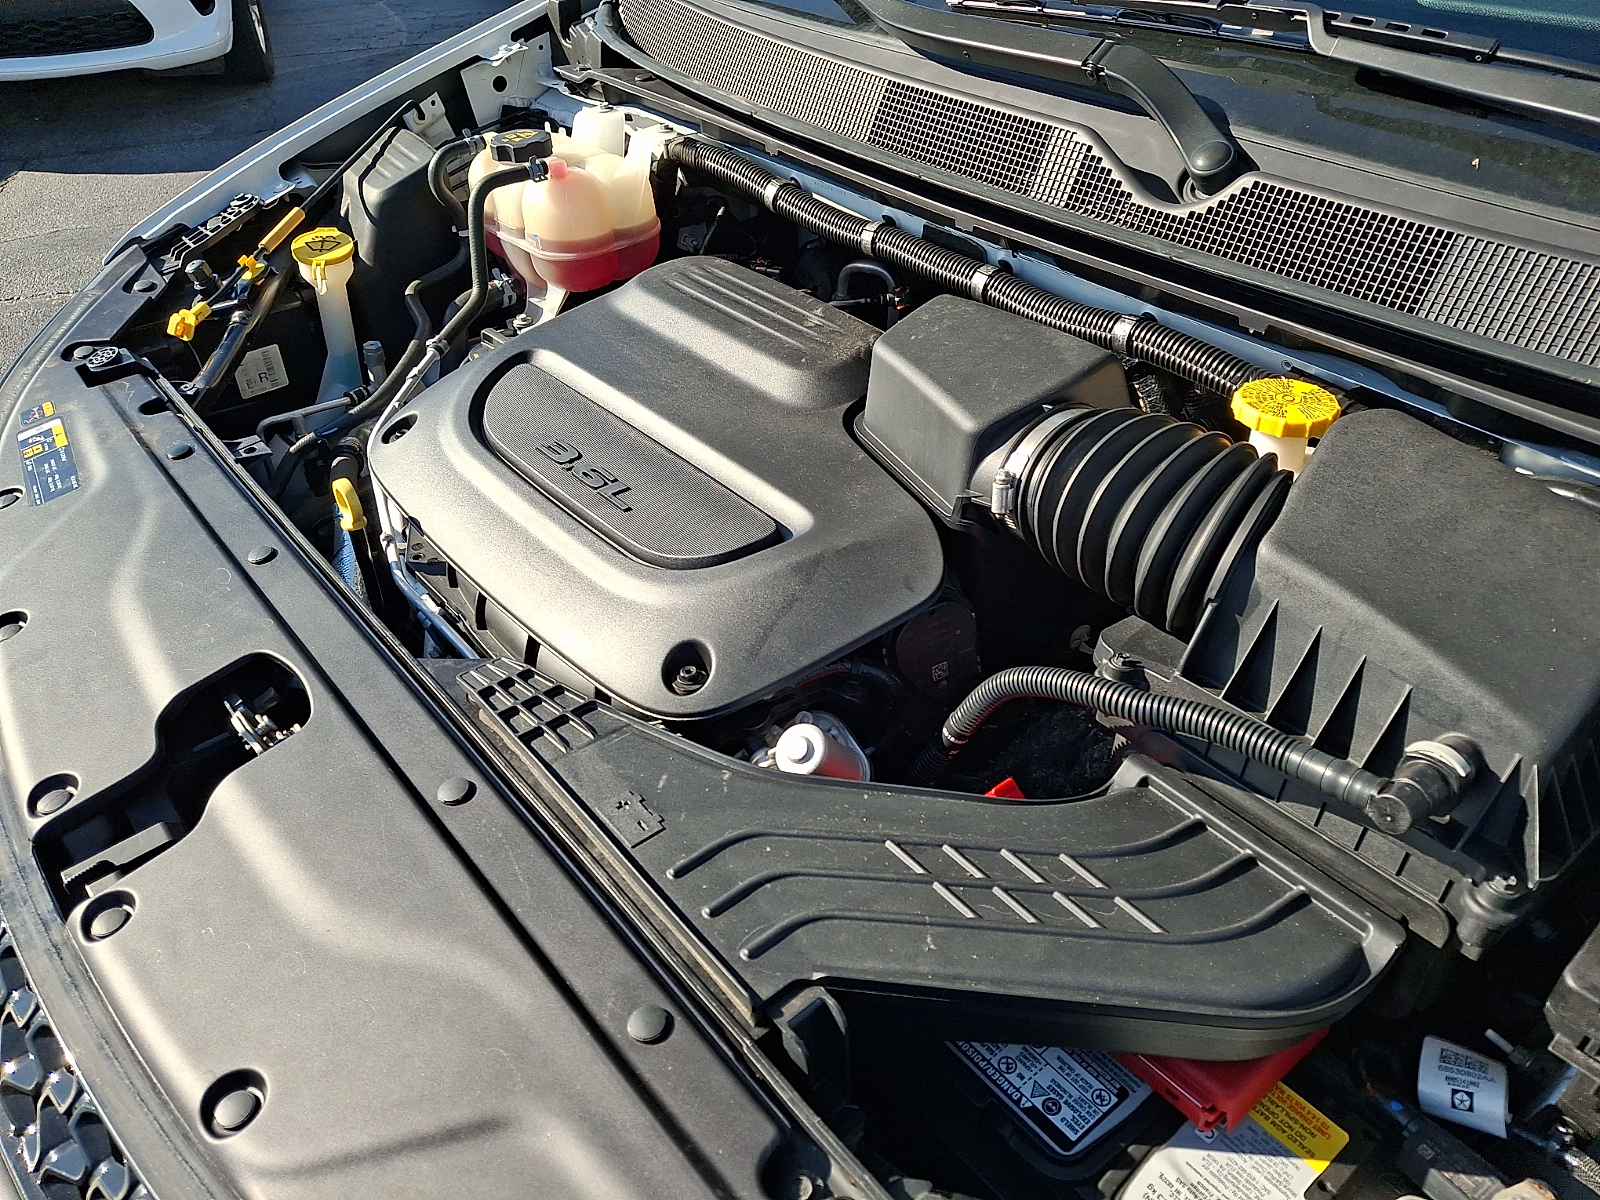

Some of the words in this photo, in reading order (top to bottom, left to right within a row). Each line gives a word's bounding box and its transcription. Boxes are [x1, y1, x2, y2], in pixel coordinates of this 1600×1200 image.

[258, 371, 269, 383] R
[535, 438, 634, 513] 3.6L
[1016, 1071, 1025, 1081] NO
[1046, 1083, 1064, 1101] GASES
[1062, 1098, 1090, 1125] EXPLOSIVE
[1285, 1093, 1307, 1112] VOLTS
[1060, 1116, 1080, 1135] SHIELD
[1269, 1118, 1288, 1136] AGM
[1277, 1116, 1294, 1131] NOT
[1294, 1129, 1307, 1141] DO
[1287, 1133, 1316, 1158] SEALED
[1145, 1182, 1158, 1195] kg
